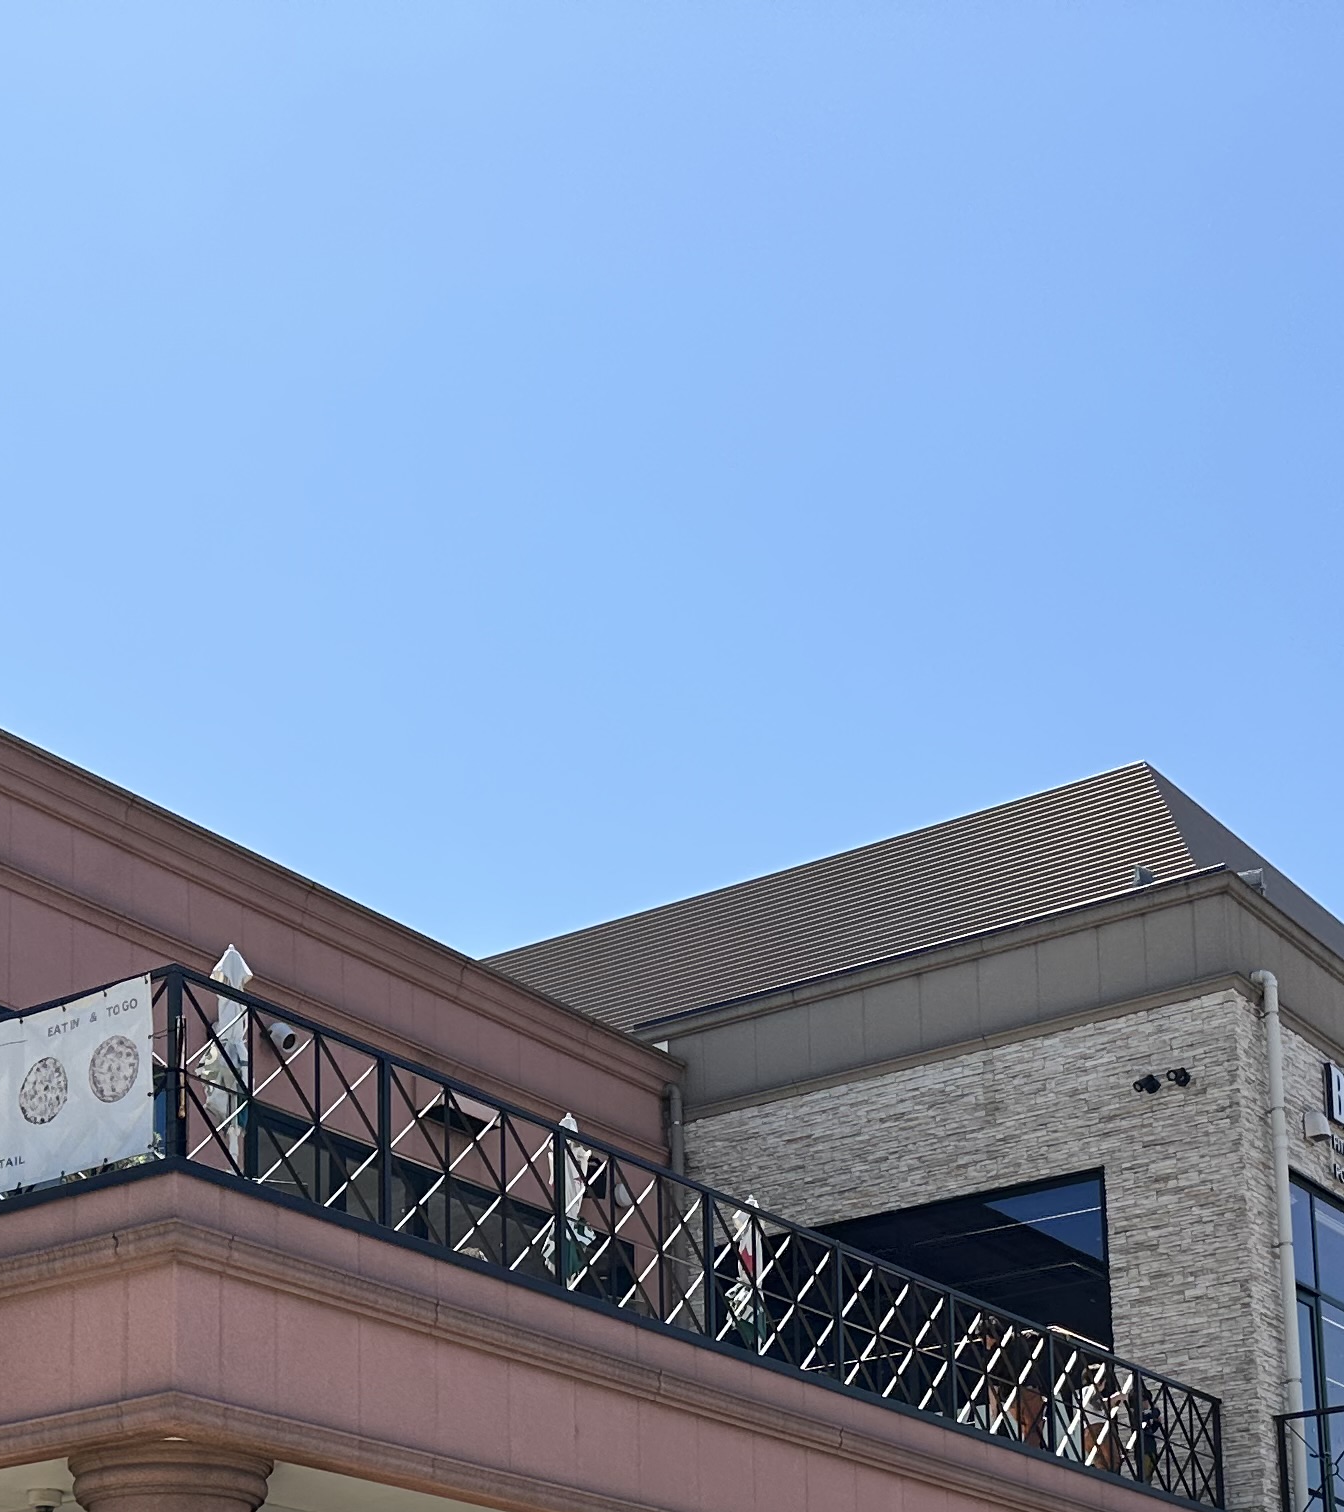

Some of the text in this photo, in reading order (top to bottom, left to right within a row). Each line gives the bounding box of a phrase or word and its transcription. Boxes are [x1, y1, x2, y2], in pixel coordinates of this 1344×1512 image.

[48, 998, 138, 1037] EAT IN & TO GO
